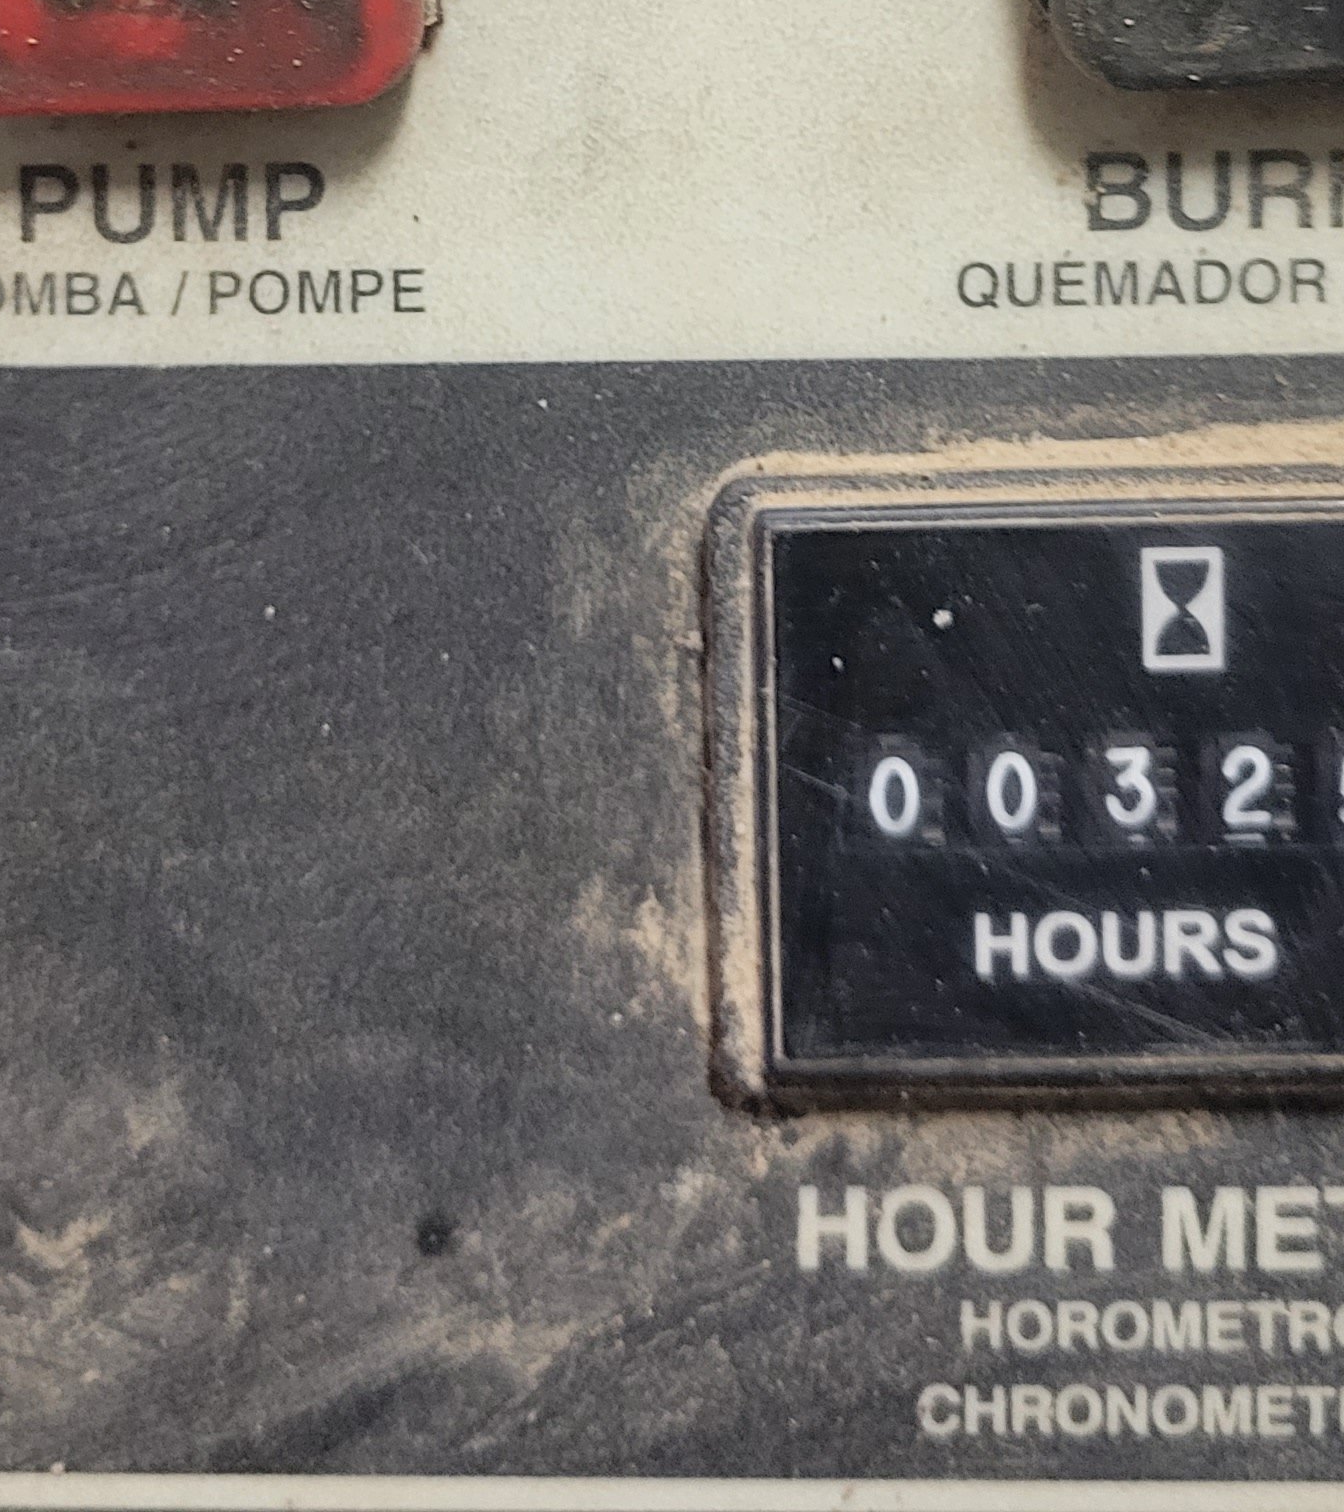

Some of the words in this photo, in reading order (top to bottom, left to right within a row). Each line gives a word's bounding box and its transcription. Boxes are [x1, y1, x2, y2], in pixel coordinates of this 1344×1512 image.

[18, 162, 326, 243] PUMP
[208, 268, 427, 314] POMPE
[974, 910, 1278, 981] HOURS
[796, 1186, 1116, 1274] HOUR
